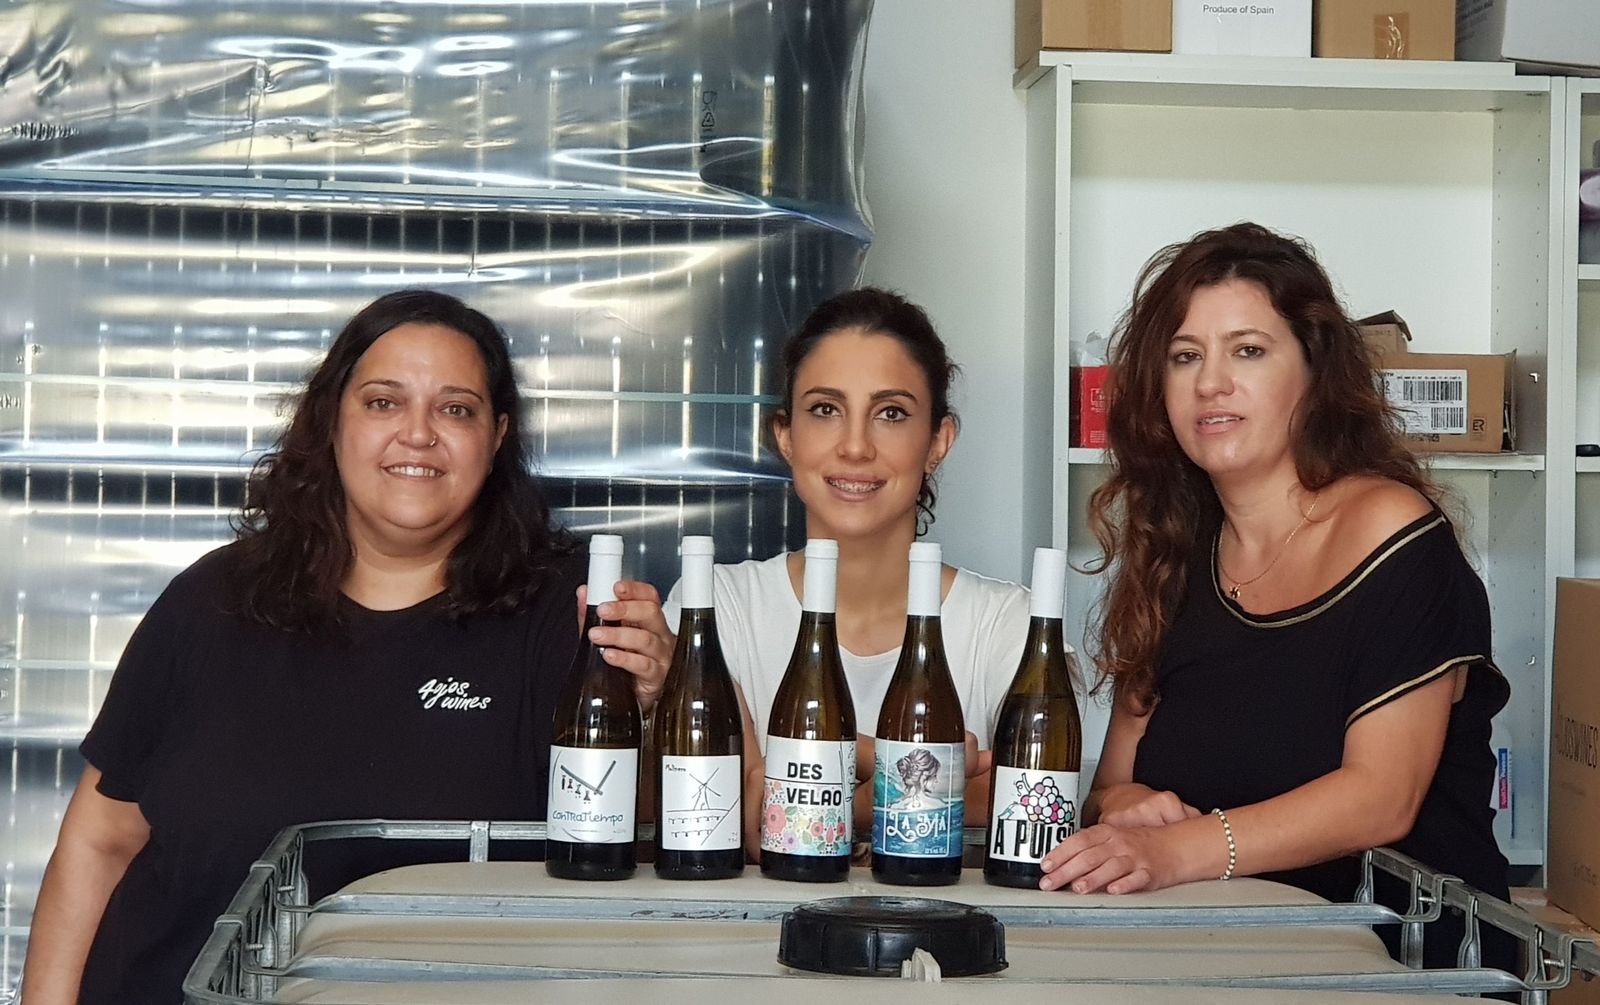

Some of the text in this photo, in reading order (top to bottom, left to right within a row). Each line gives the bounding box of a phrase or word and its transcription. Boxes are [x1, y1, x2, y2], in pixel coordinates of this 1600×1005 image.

[1203, 4, 1275, 15] Produce of Spain
[441, 693, 492, 711] wines
[787, 762, 823, 780] DES
[786, 787, 842, 806] VELAO
[993, 819, 1075, 859] A PUL
